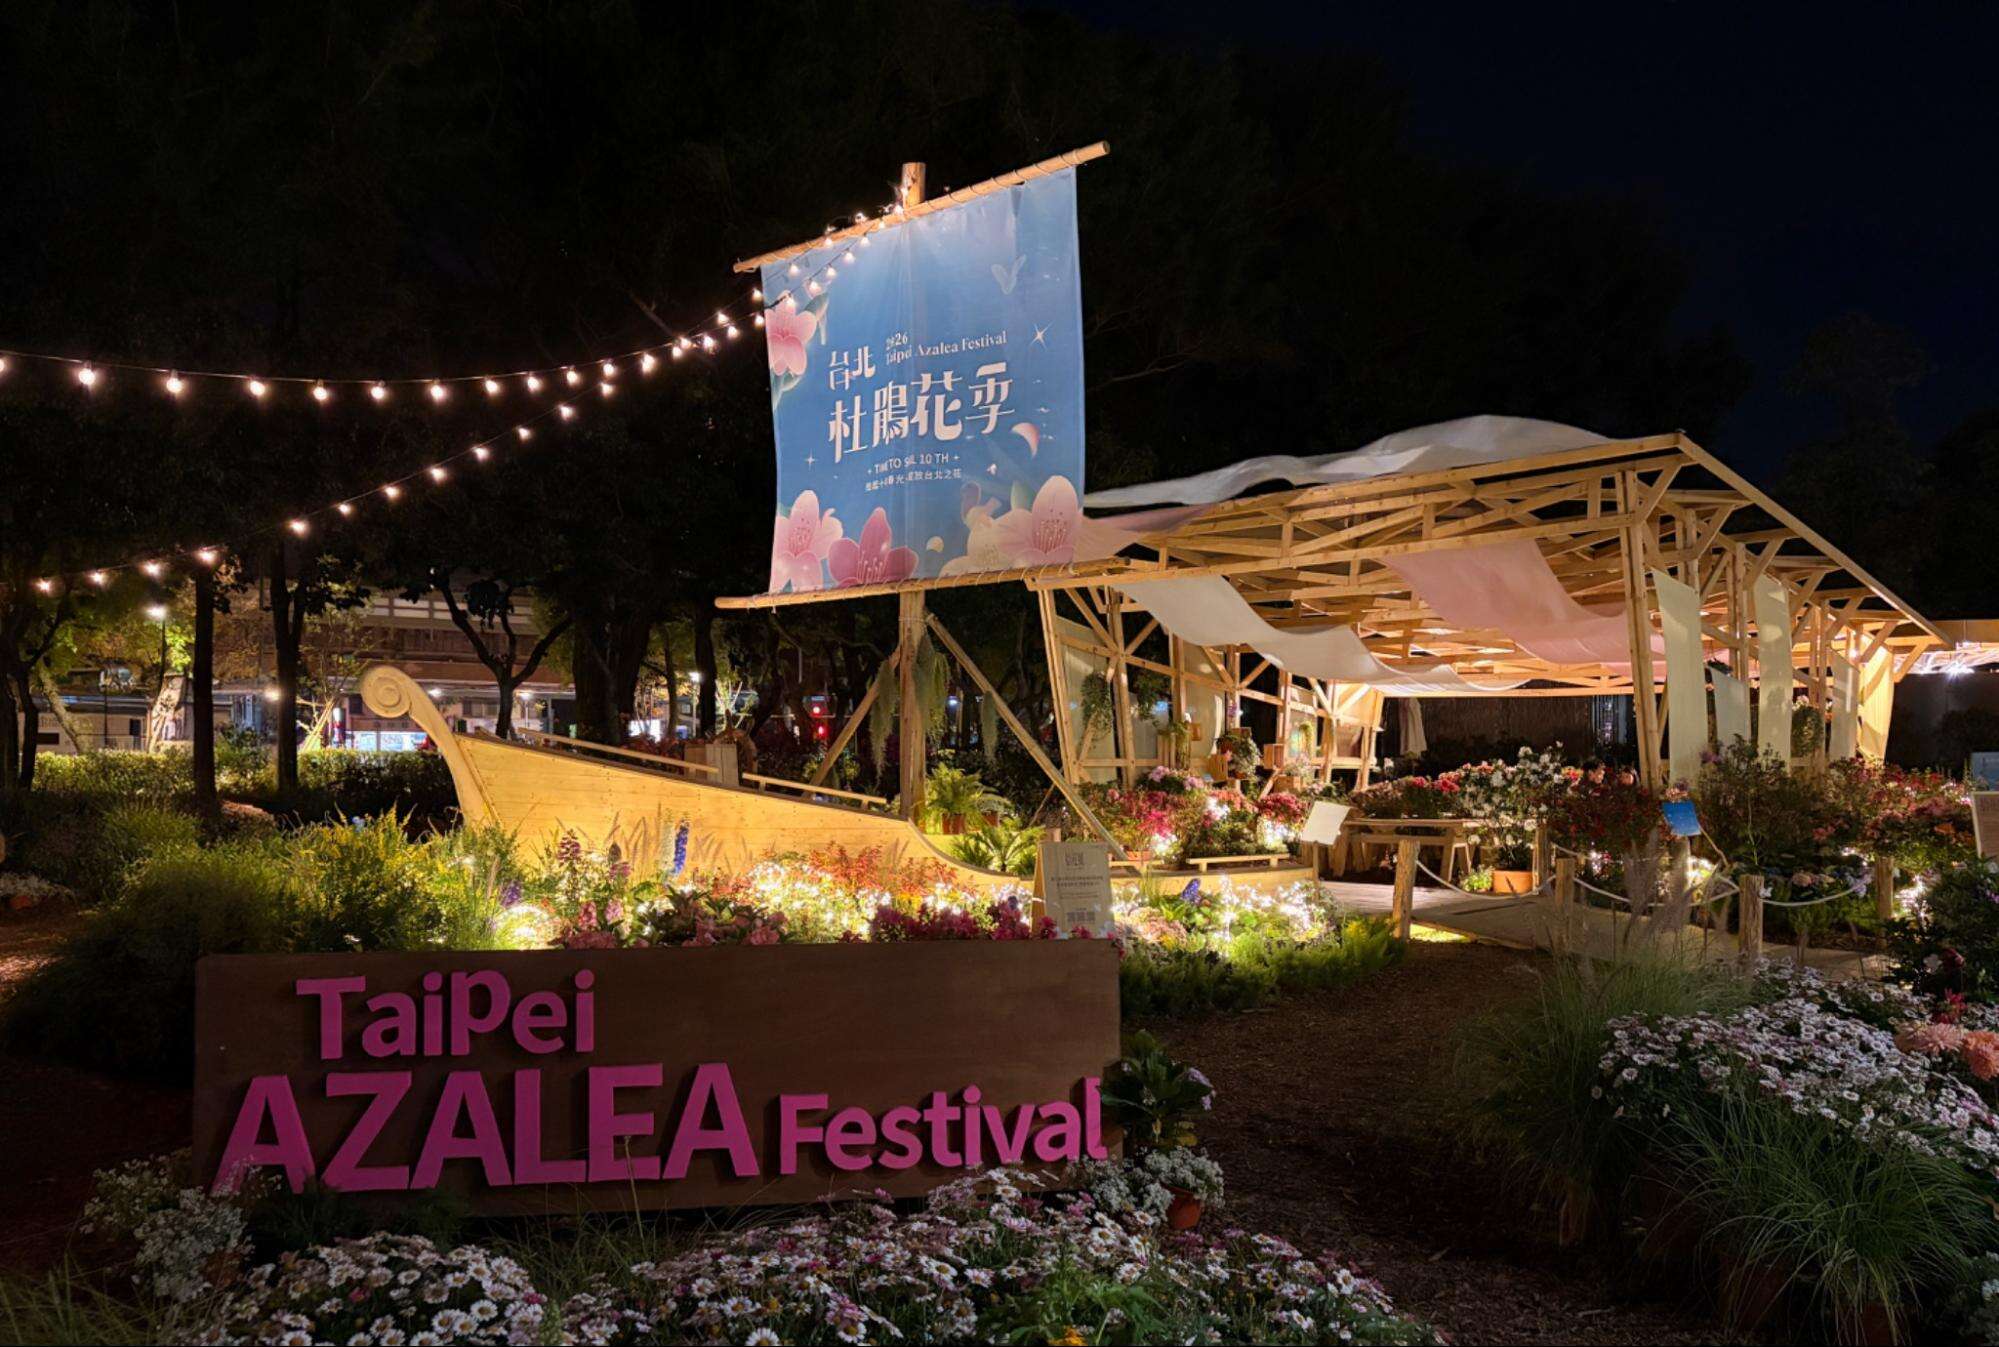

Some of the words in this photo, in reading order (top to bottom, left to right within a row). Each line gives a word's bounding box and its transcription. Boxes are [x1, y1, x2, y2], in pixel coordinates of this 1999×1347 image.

[917, 342, 958, 357] Azalea
[962, 331, 1007, 351] Festival
[829, 345, 876, 391] 台北
[828, 361, 1015, 464] 杜鵑花季
[920, 453, 933, 465] 10
[934, 452, 949, 464] TH
[210, 1062, 760, 1197] AZALEA
[779, 1077, 1109, 1175] Festival
